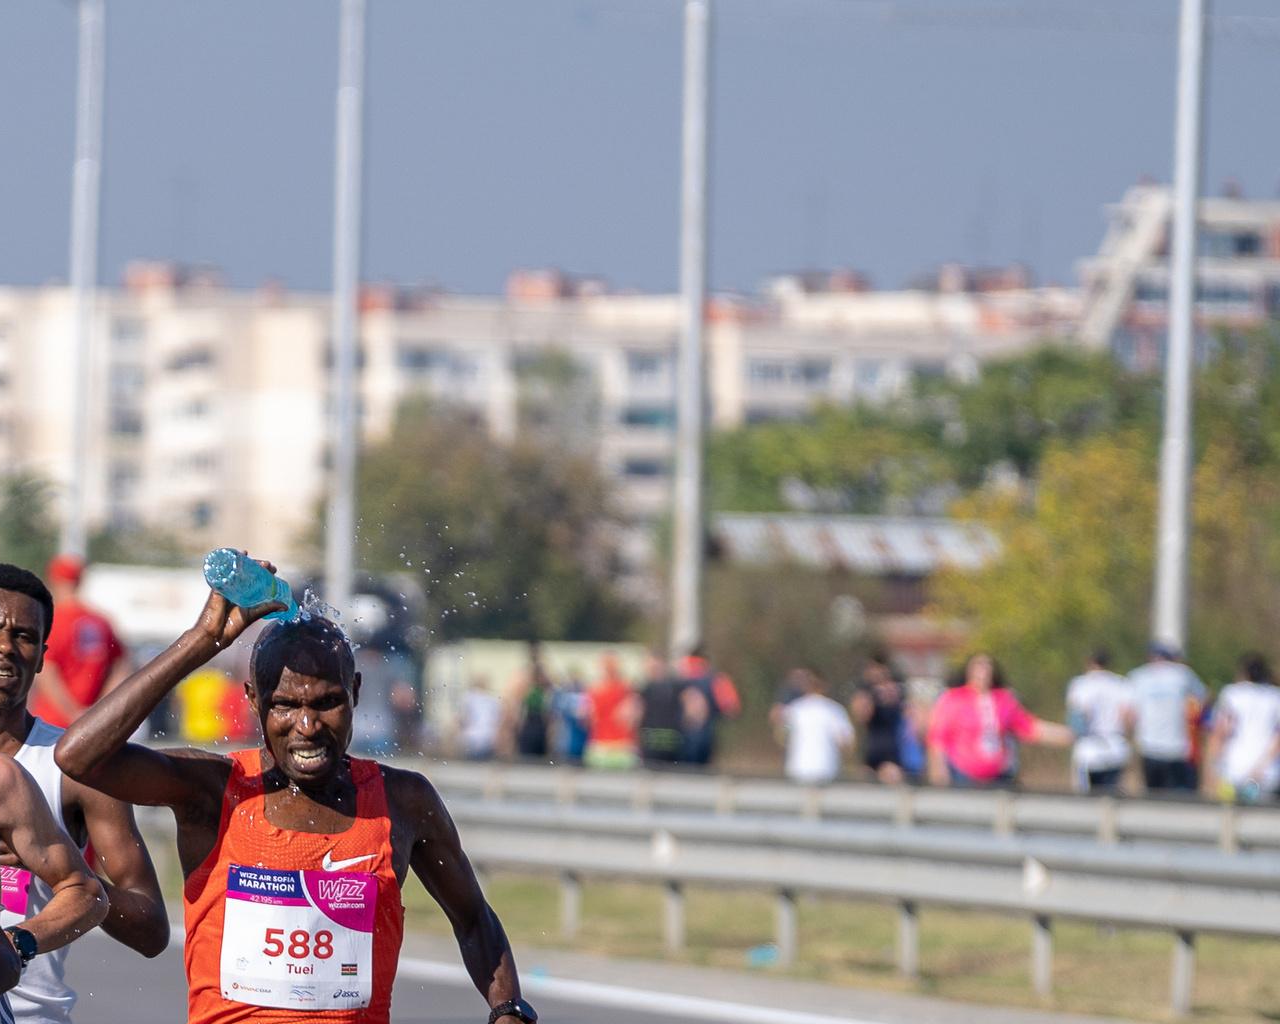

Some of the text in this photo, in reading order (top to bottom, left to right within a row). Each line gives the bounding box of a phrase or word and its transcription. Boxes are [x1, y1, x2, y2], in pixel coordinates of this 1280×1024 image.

[239, 871, 295, 883] WIZZ AIR SOFIA
[238, 878, 295, 893] MARATHON
[262, 927, 334, 959] 588
[286, 963, 314, 975] Tuei
